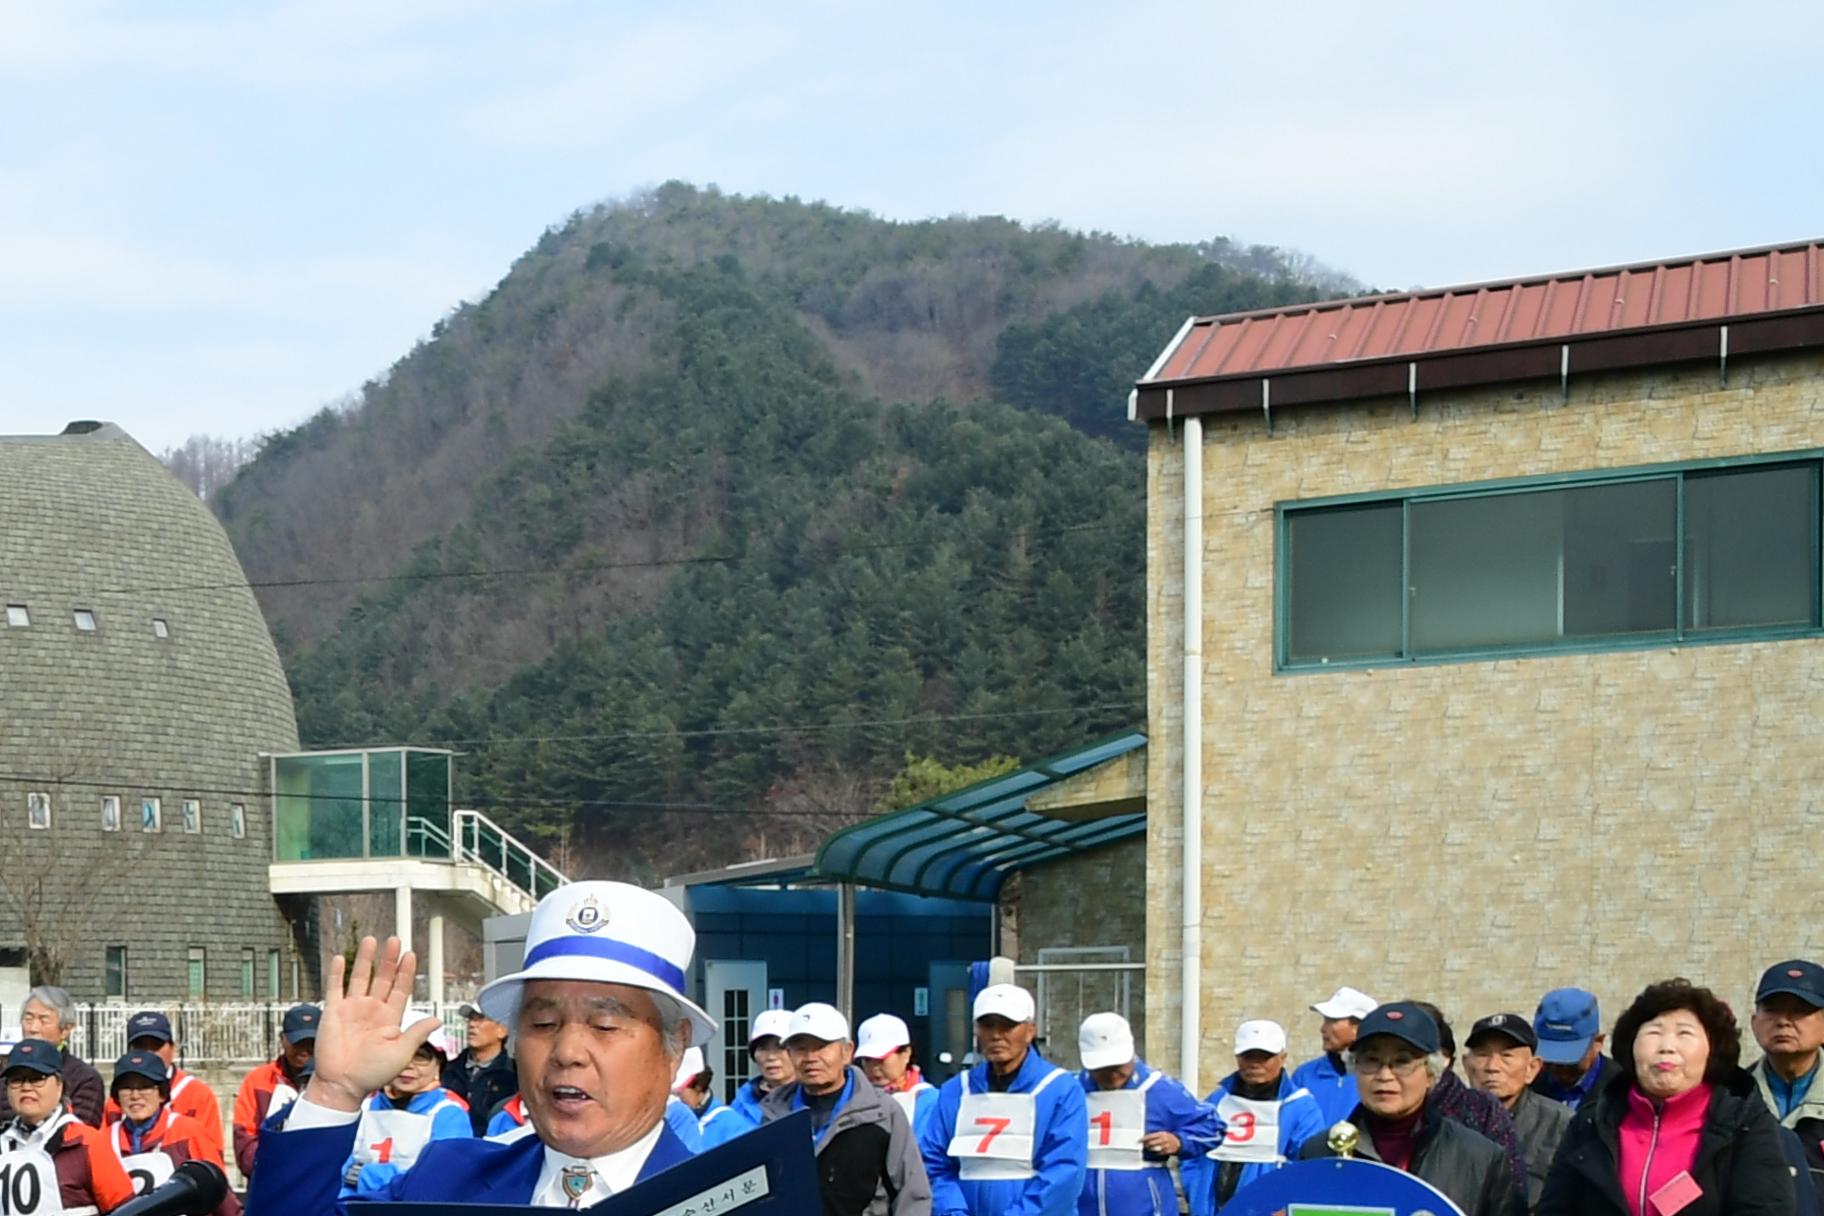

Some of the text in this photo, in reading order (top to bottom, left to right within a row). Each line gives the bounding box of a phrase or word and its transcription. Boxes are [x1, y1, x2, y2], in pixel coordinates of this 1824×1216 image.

[975, 1117, 1011, 1153] 7
[1091, 1111, 1112, 1146] 1
[1226, 1111, 1256, 1142] 3
[370, 1136, 393, 1164] 1
